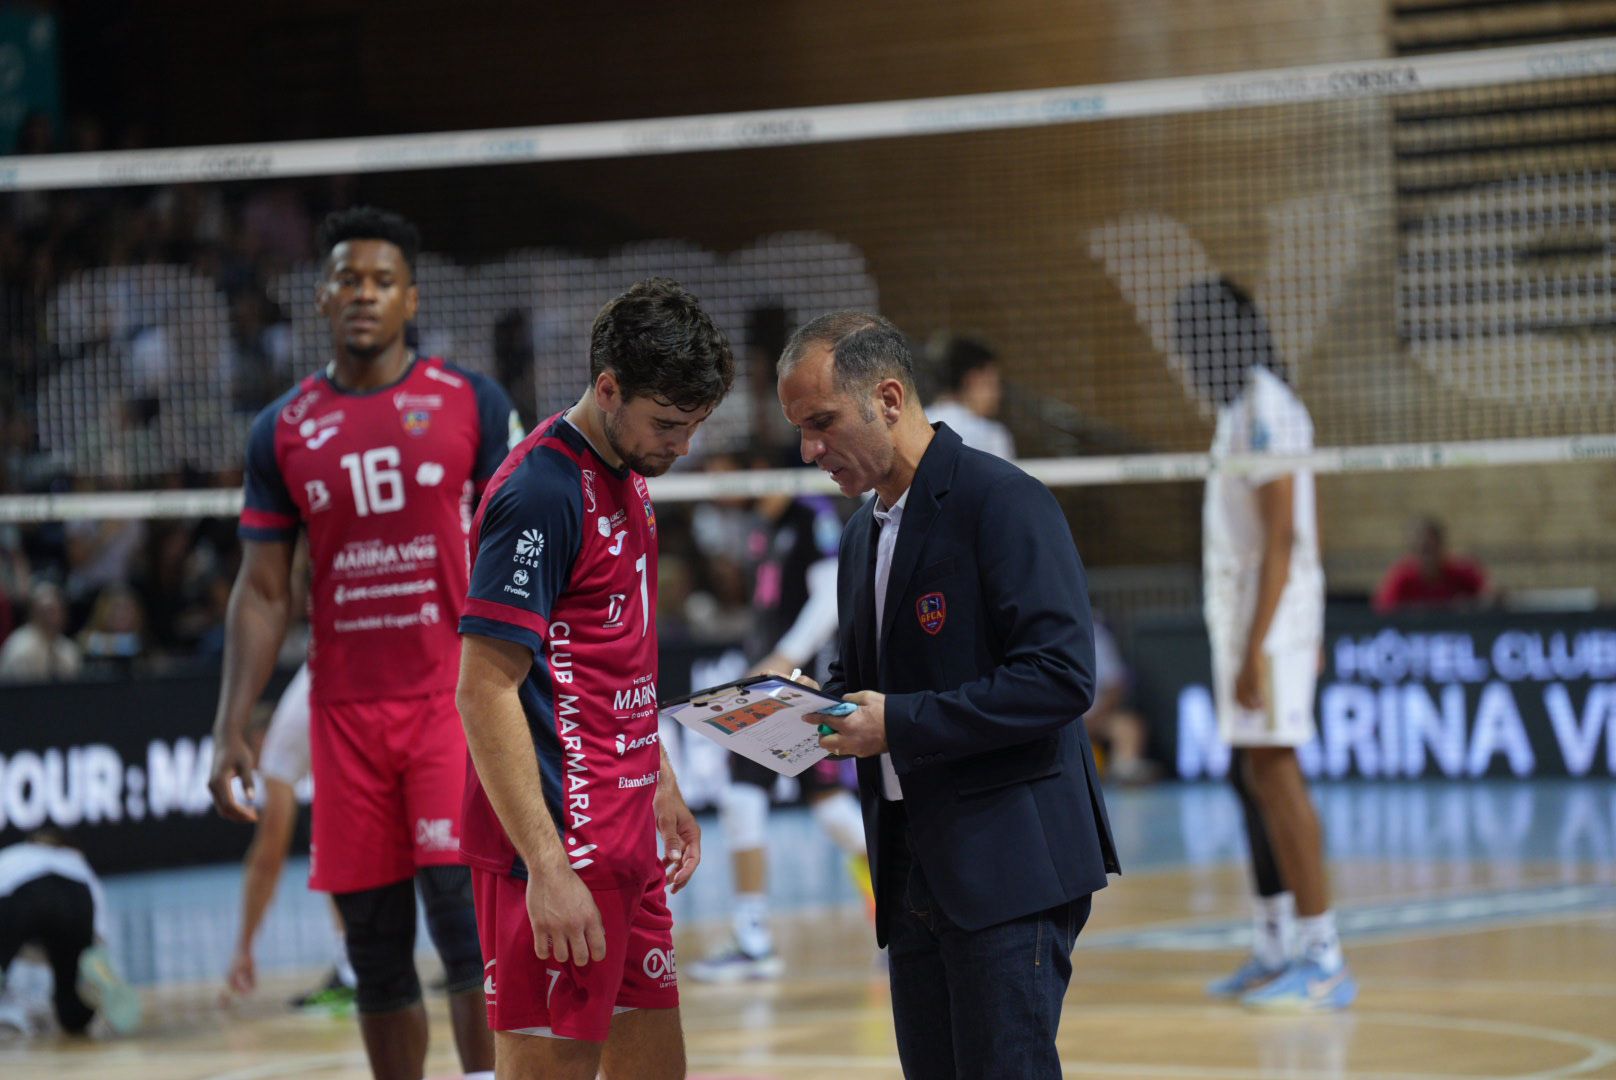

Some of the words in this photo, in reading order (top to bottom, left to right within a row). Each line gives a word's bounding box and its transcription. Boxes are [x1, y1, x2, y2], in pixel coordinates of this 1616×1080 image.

[340, 446, 405, 517] 16
[513, 554, 538, 568] CCAS
[549, 621, 574, 684] CLUB
[557, 693, 592, 830] MARMARA
[1177, 682, 1536, 778] MRINA
[0, 743, 124, 830] OUR
[546, 968, 561, 1009] 7
